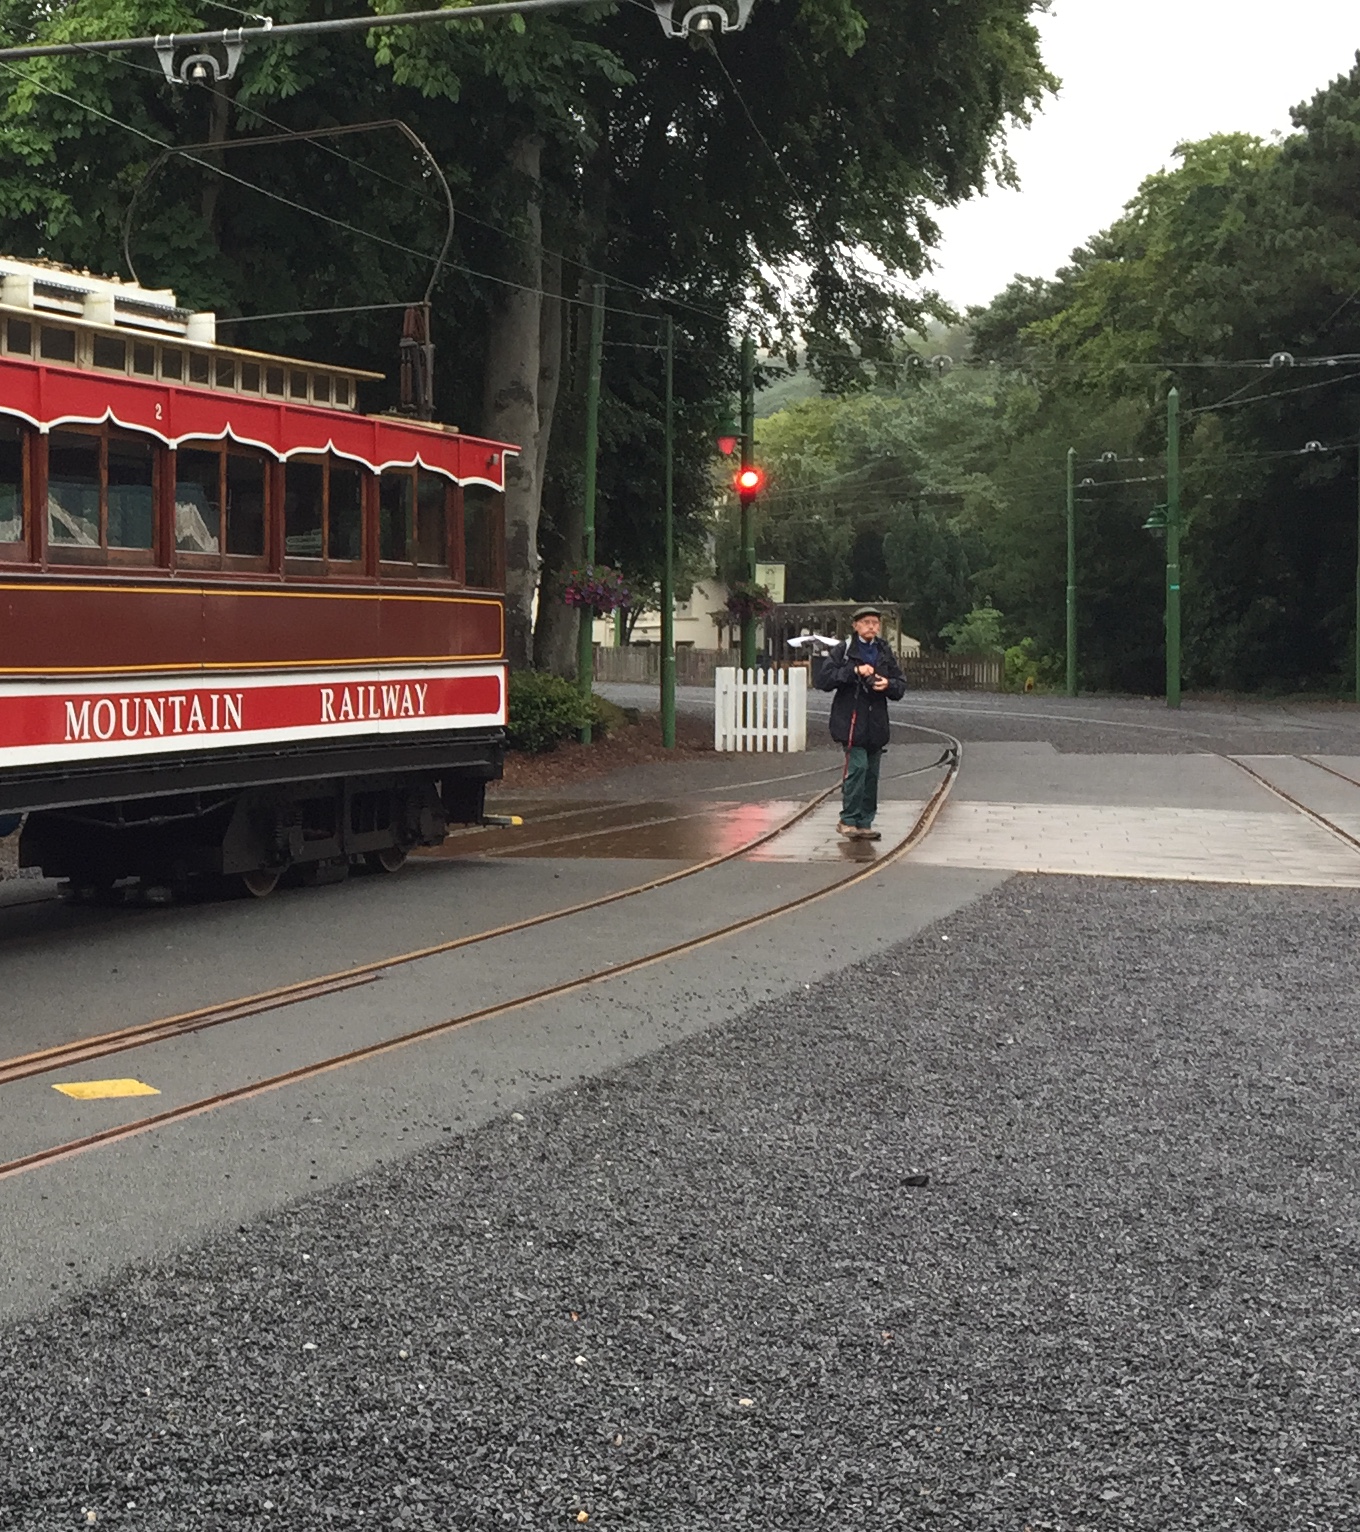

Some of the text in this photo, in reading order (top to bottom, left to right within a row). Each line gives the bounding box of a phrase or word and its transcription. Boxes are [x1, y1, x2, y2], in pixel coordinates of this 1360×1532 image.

[155, 403, 163, 420] 2
[64, 693, 244, 741] MOUNTAIN
[320, 683, 428, 723] RAILWAY
